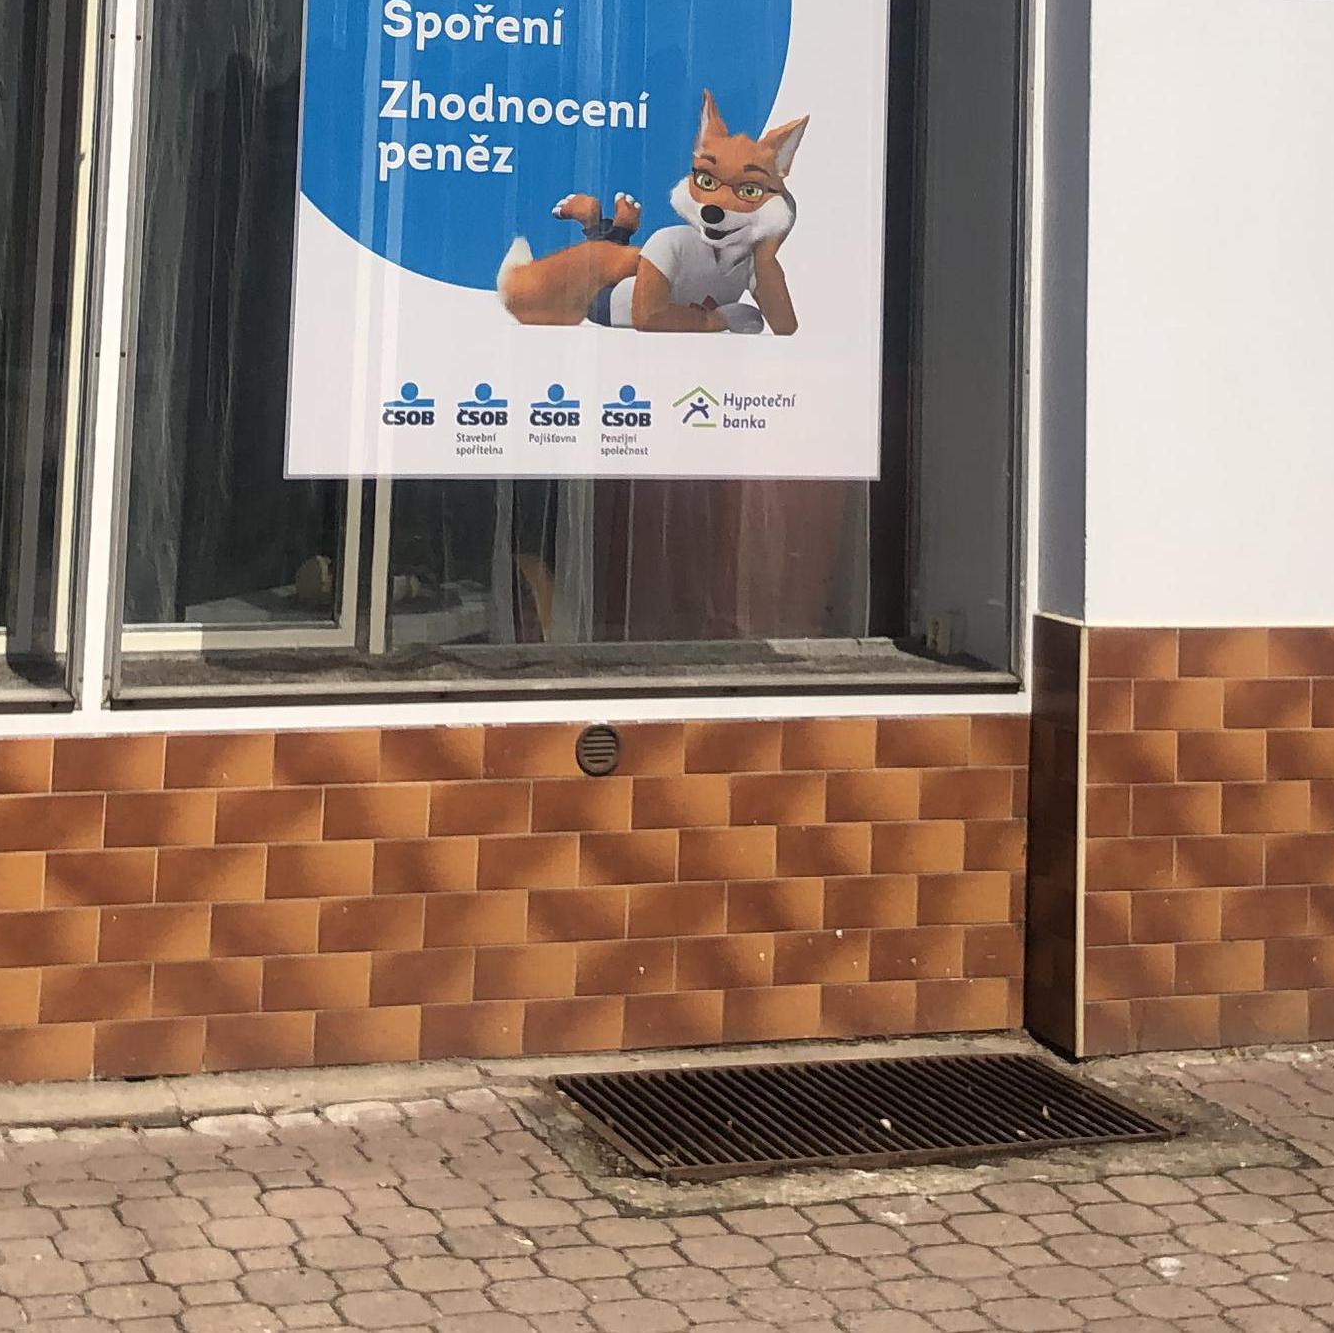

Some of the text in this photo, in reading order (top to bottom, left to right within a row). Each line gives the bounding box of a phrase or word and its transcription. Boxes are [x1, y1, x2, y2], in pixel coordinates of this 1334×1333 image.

[382, 0, 564, 51] Spoření
[378, 80, 649, 129] Zhodnocení
[378, 134, 514, 182] peněz
[723, 393, 795, 410] Hypoteční
[382, 408, 435, 426] ČSOB
[457, 409, 508, 427] ČSOB
[530, 410, 580, 428] ČSOB
[602, 410, 651, 428] ČSOB
[723, 414, 766, 429] banka
[456, 432, 496, 444] Stavební
[529, 432, 577, 445] Pojišťovna
[601, 433, 637, 446] Penzijní
[456, 445, 504, 457] spořitelna
